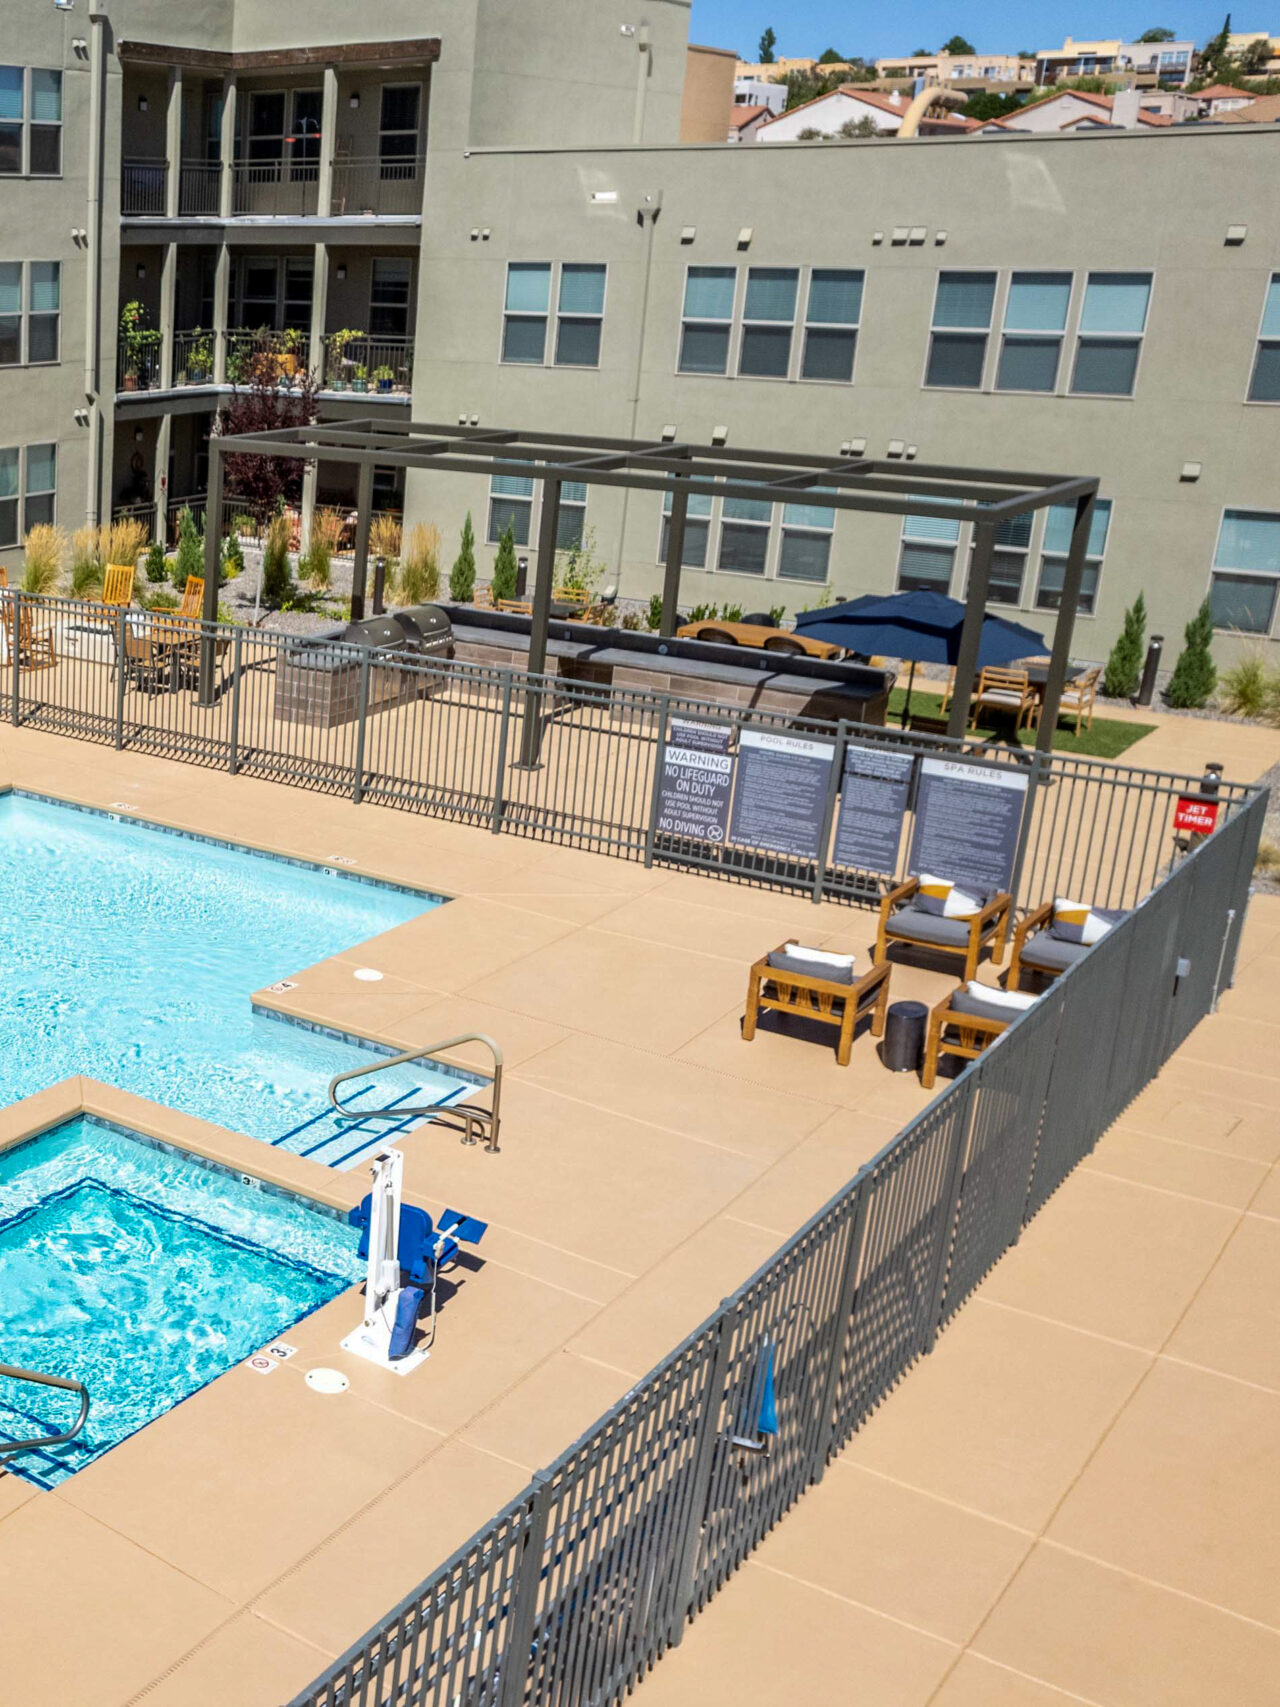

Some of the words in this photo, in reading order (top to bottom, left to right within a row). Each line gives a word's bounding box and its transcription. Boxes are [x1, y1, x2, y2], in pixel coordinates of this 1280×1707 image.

[760, 735, 782, 745] POOL
[785, 739, 814, 751] RULES
[668, 749, 729, 770] WARNING
[665, 764, 679, 777] NO
[680, 767, 730, 787] LIFEGUARD
[944, 762, 965, 773] SPA
[967, 766, 1003, 779] RULES
[676, 779, 690, 792] ON
[691, 782, 716, 797] DUTY
[661, 790, 689, 801] CHILDREN
[689, 795, 711, 806] SHOULD
[711, 799, 724, 809] NOT
[665, 799, 676, 808] USE
[676, 801, 691, 810] POOL
[692, 804, 718, 815] WITHOUT
[663, 807, 681, 816] ADULT
[682, 811, 718, 823] SUPERVISION
[1186, 804, 1208, 815] JET
[659, 816, 673, 830] NO
[674, 820, 705, 836] DIVING
[1177, 812, 1213, 827] TIMER
